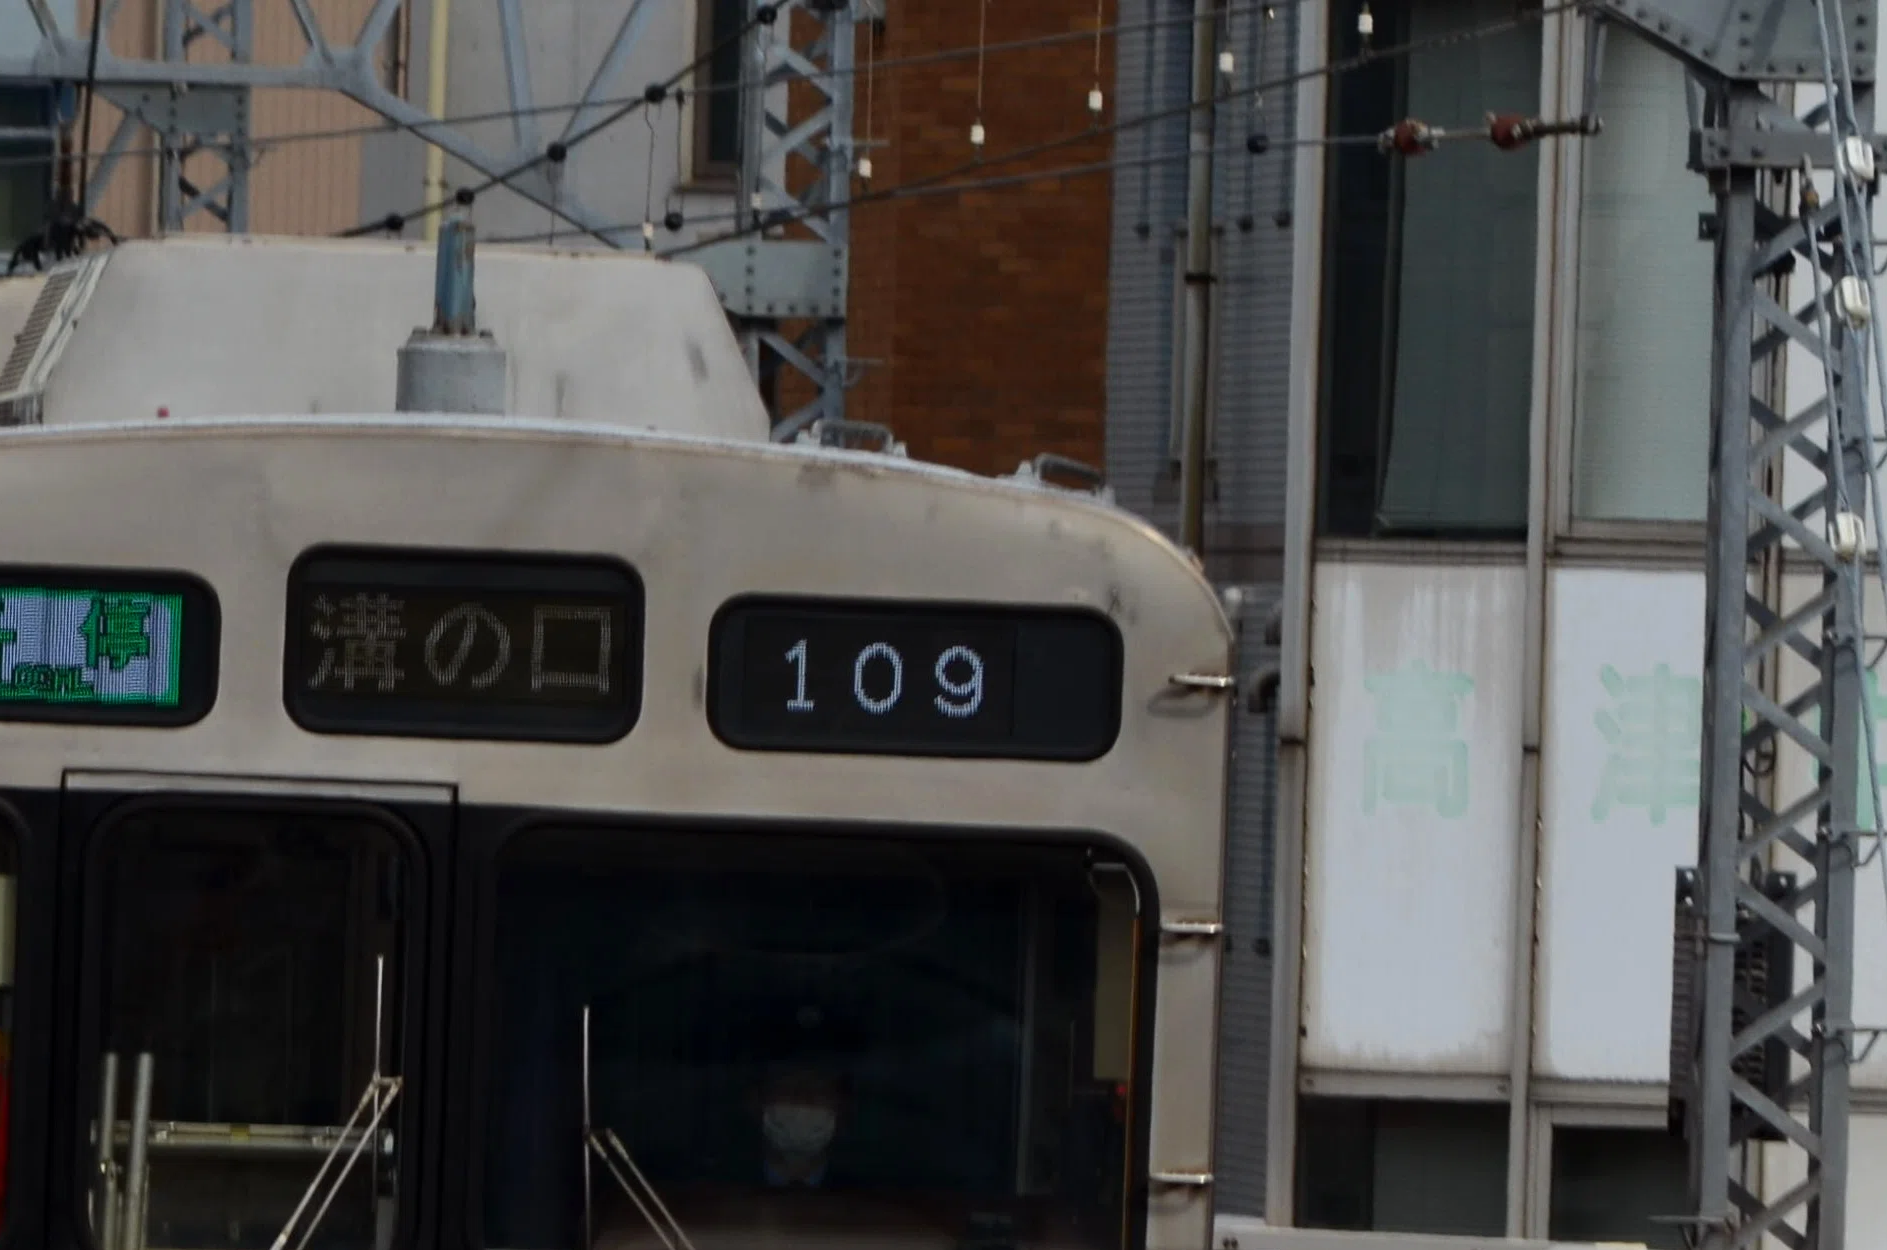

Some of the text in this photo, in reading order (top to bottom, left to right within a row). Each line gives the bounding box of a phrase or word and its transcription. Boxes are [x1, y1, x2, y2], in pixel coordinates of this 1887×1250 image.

[308, 592, 612, 695] 溝の口
[784, 638, 985, 718] 109
